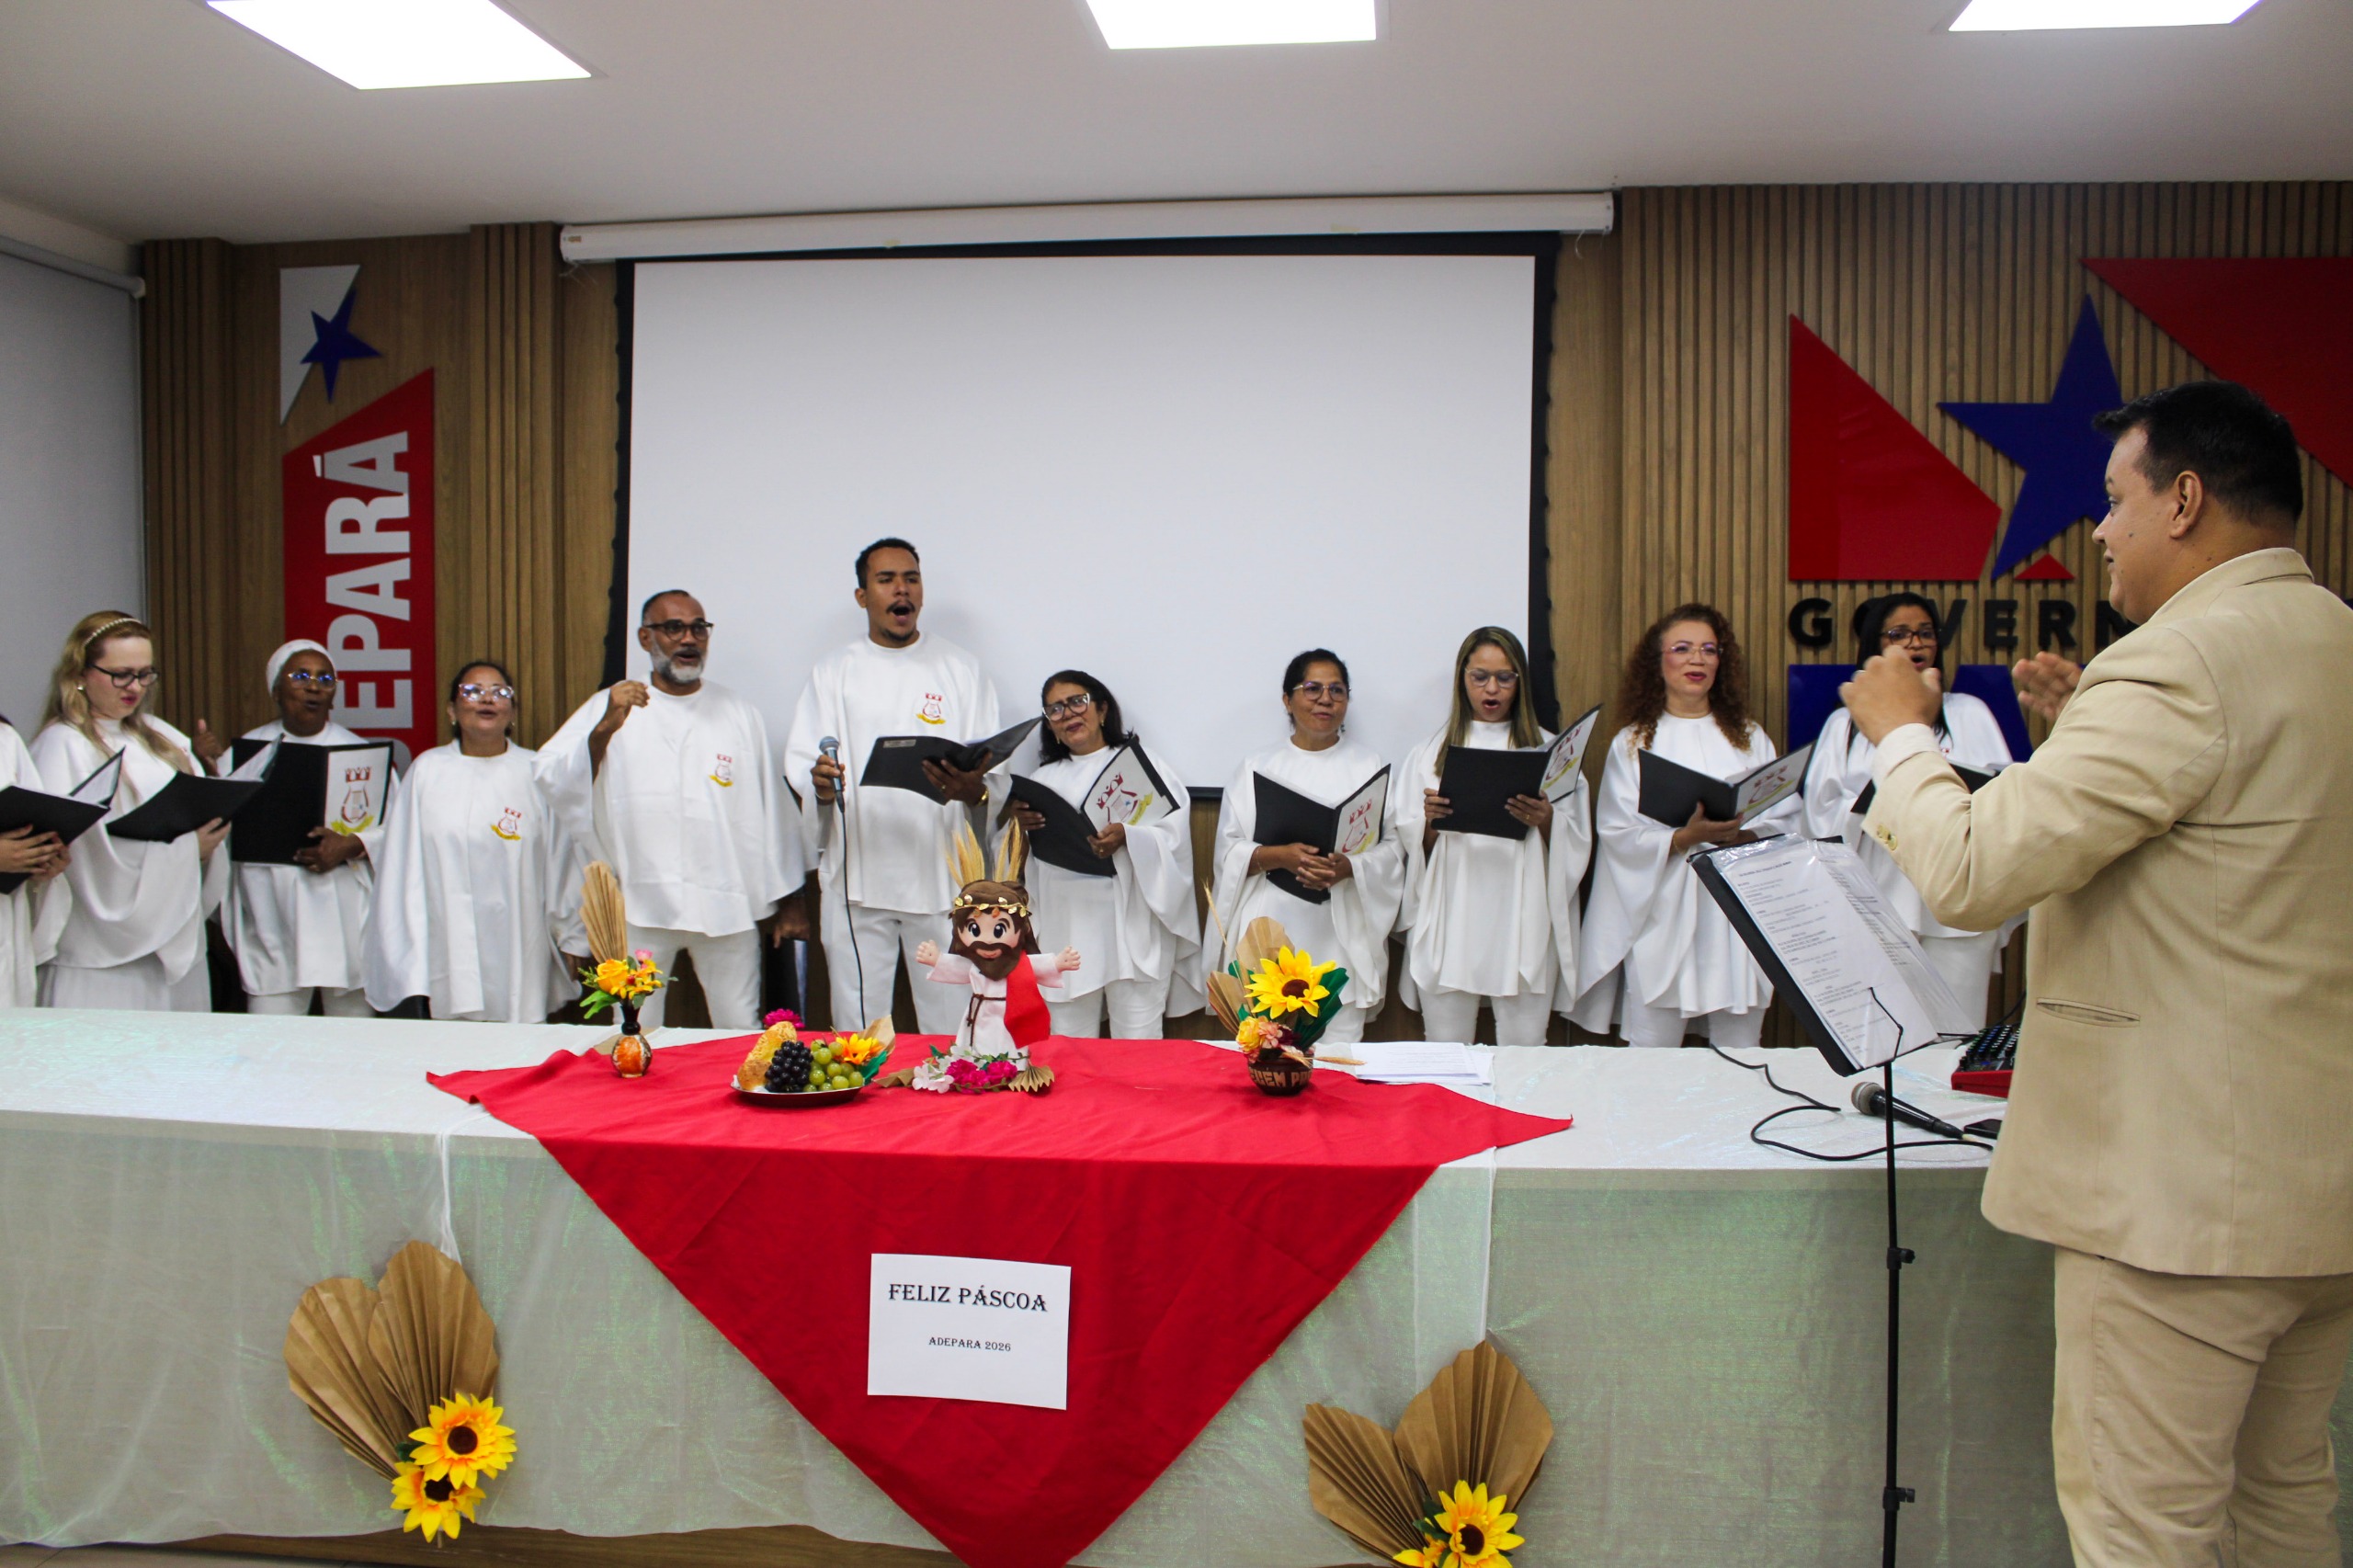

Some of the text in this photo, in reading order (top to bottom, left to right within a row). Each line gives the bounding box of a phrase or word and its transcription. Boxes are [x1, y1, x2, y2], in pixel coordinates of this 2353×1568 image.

[1789, 597, 2139, 650] GVERN
[888, 1283, 1048, 1312] FELIZ PÁSCOA
[928, 1336, 1012, 1352] ADEPARA 2026
